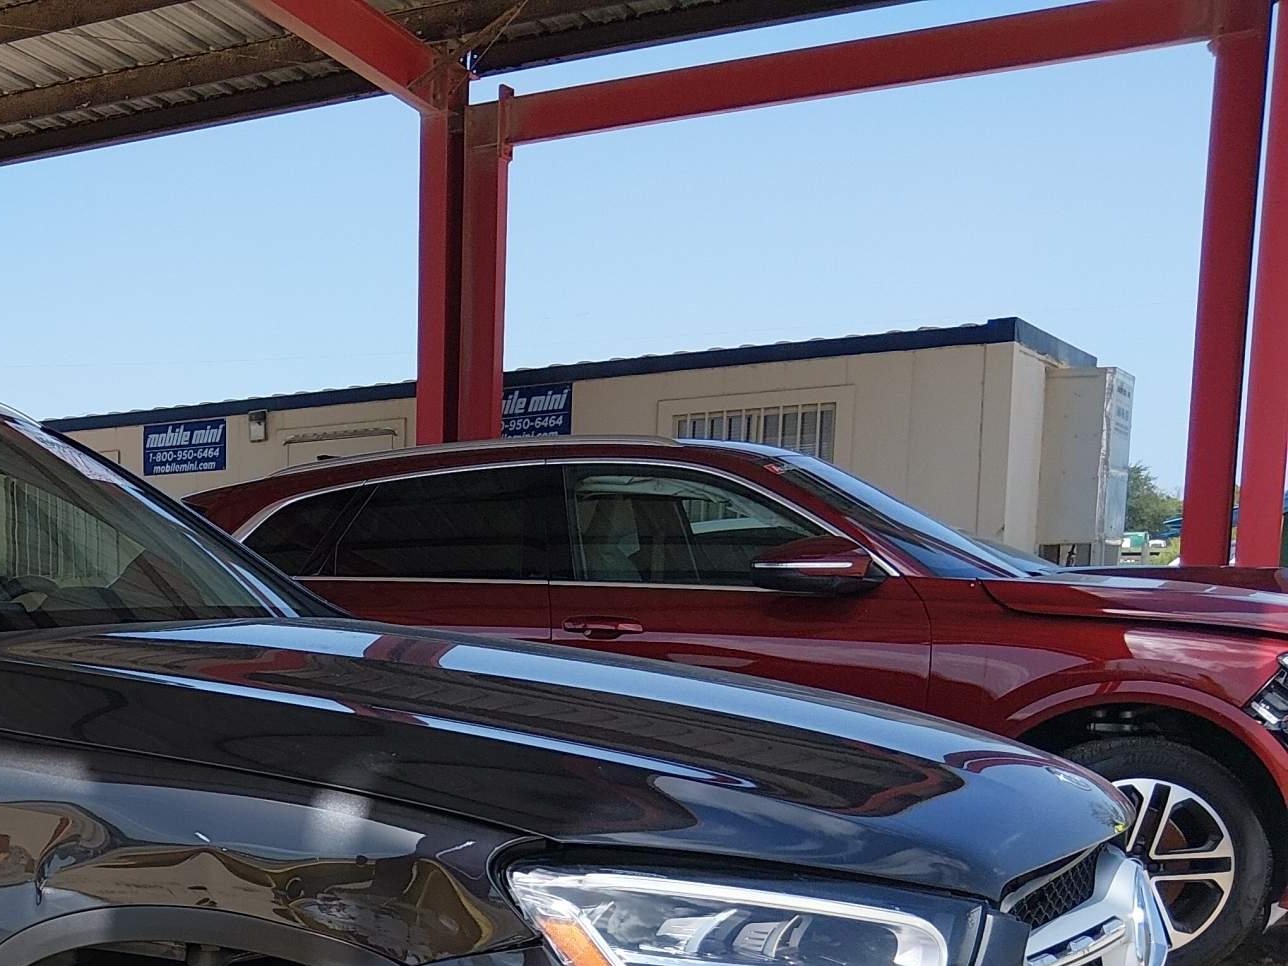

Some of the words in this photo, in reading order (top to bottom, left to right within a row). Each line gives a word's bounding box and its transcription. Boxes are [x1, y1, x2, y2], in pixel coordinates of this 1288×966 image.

[528, 388, 568, 412] mini
[501, 415, 563, 431] -950-6464
[146, 424, 191, 448] mobile
[192, 424, 225, 444] mini
[149, 448, 220, 463] 1-800-950-6464
[153, 461, 216, 475] mobilemini.com
